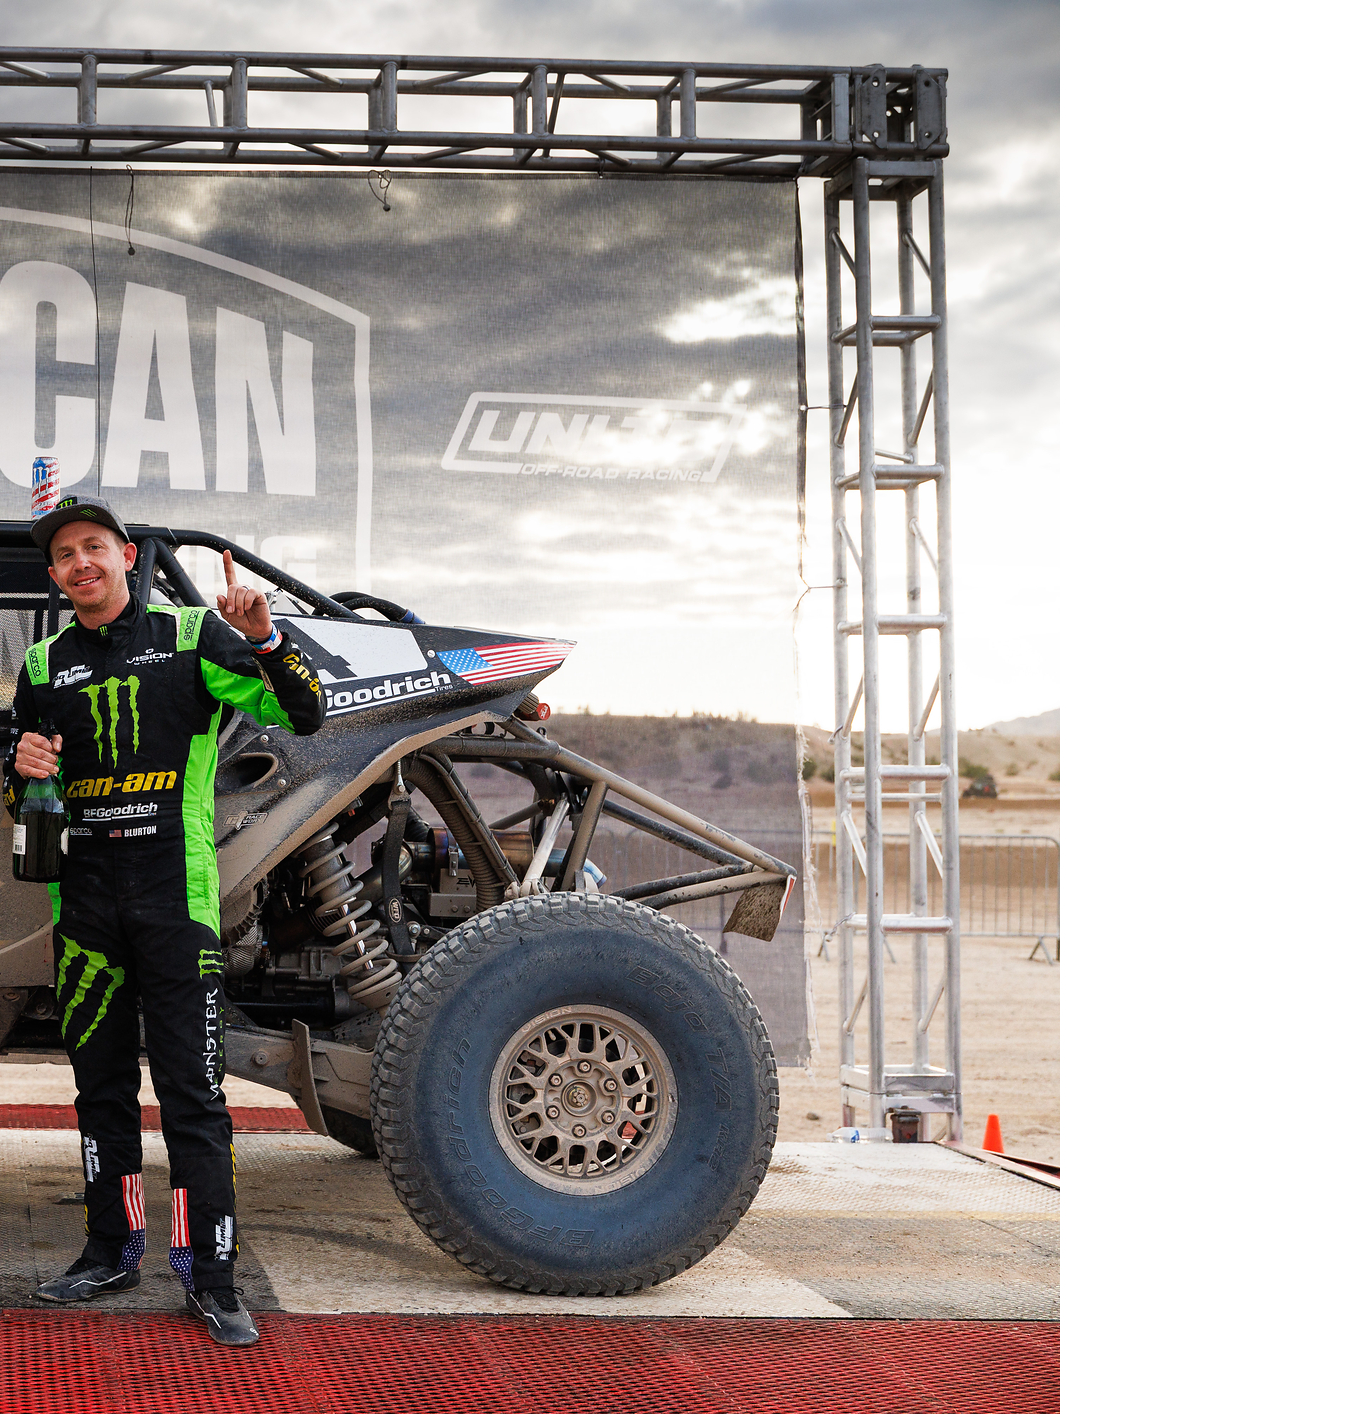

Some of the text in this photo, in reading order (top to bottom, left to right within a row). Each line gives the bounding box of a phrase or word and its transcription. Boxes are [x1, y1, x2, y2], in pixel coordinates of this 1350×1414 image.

[521, 463, 703, 482] OFF-ROAD RACING
[183, 610, 200, 641] sparco
[28, 648, 42, 678] sparco
[126, 652, 174, 664] VISION
[326, 671, 451, 709] Goodrich
[66, 770, 177, 798] can-am
[83, 802, 158, 818] BFGoodrich
[124, 825, 157, 837] BLURTON
